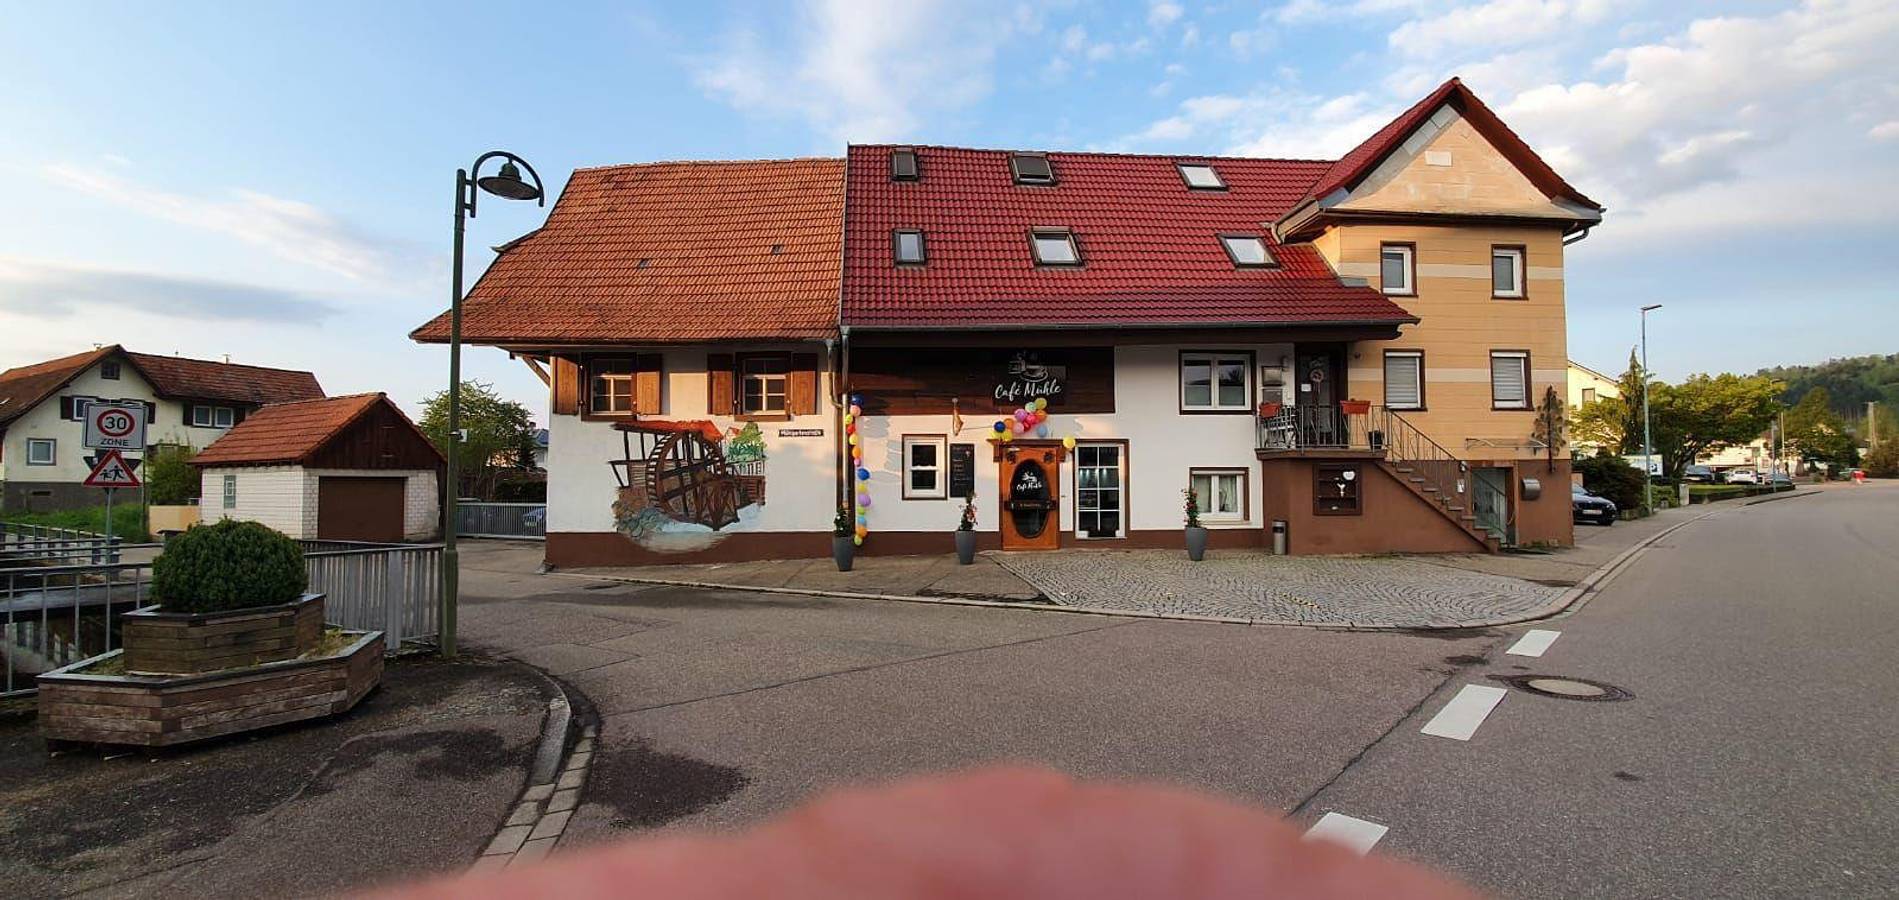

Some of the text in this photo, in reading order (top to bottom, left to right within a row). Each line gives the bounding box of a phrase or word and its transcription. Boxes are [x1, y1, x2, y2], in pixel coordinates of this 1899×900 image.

[995, 378, 1062, 402] Café Mühle
[104, 416, 127, 430] 30
[100, 438, 129, 447] ZONE
